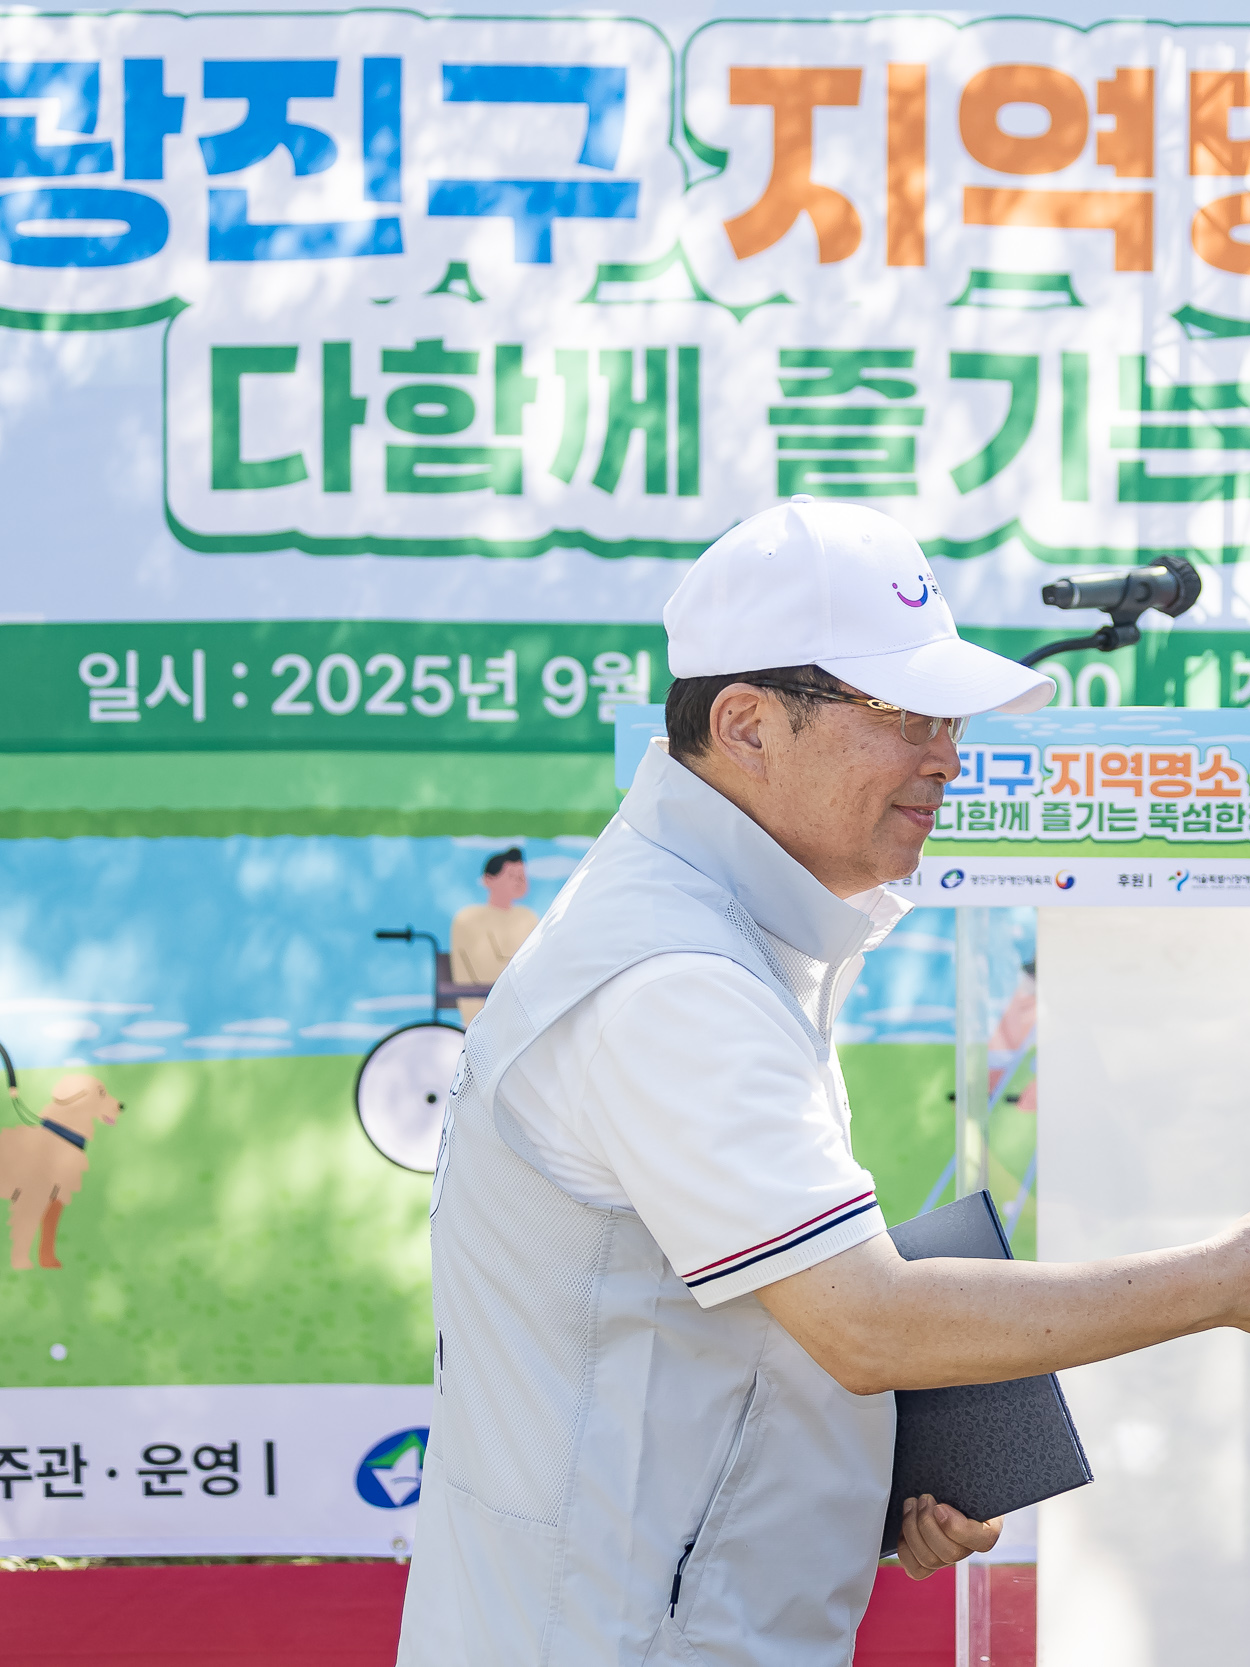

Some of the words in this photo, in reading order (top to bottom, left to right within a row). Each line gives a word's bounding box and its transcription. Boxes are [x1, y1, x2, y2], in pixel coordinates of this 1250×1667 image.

[0, 56, 641, 269] 광진구
[210, 339, 701, 497] 다함께
[78, 649, 207, 722] 일시
[271, 650, 519, 721] 2025년
[541, 650, 651, 721] 9월
[945, 752, 1034, 796] 진구
[1051, 752, 1242, 798] 지역명소
[934, 801, 1030, 832] 다함께
[1041, 802, 1138, 832] 즐기는
[1119, 873, 1144, 888] 후원
[0, 1443, 88, 1499] 주관
[137, 1442, 240, 1496] 운영
